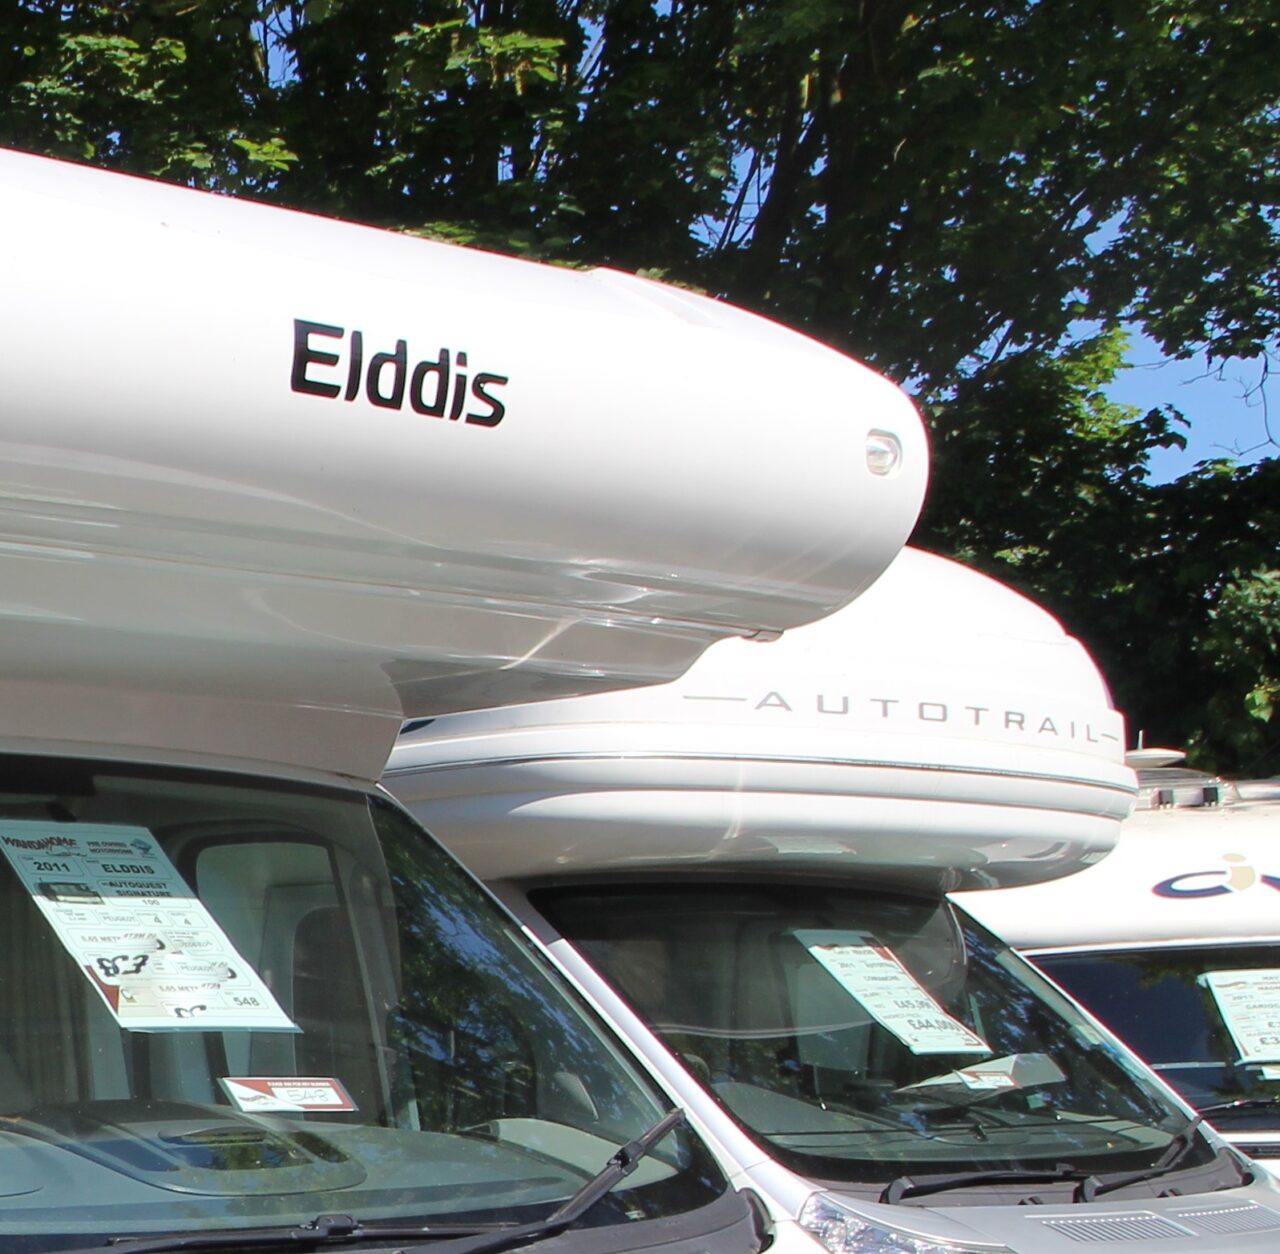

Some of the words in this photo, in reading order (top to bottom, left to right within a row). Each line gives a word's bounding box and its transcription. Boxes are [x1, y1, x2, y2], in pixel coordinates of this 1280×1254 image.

[290, 317, 509, 429] Elddis
[753, 690, 1100, 743] AUTOTRAIL
[33, 861, 71, 873] 2011
[102, 863, 155, 875] ELDDIS
[108, 880, 168, 890] AUTOQUEST
[233, 996, 260, 1007] 548
[285, 1088, 329, 1102] 548
